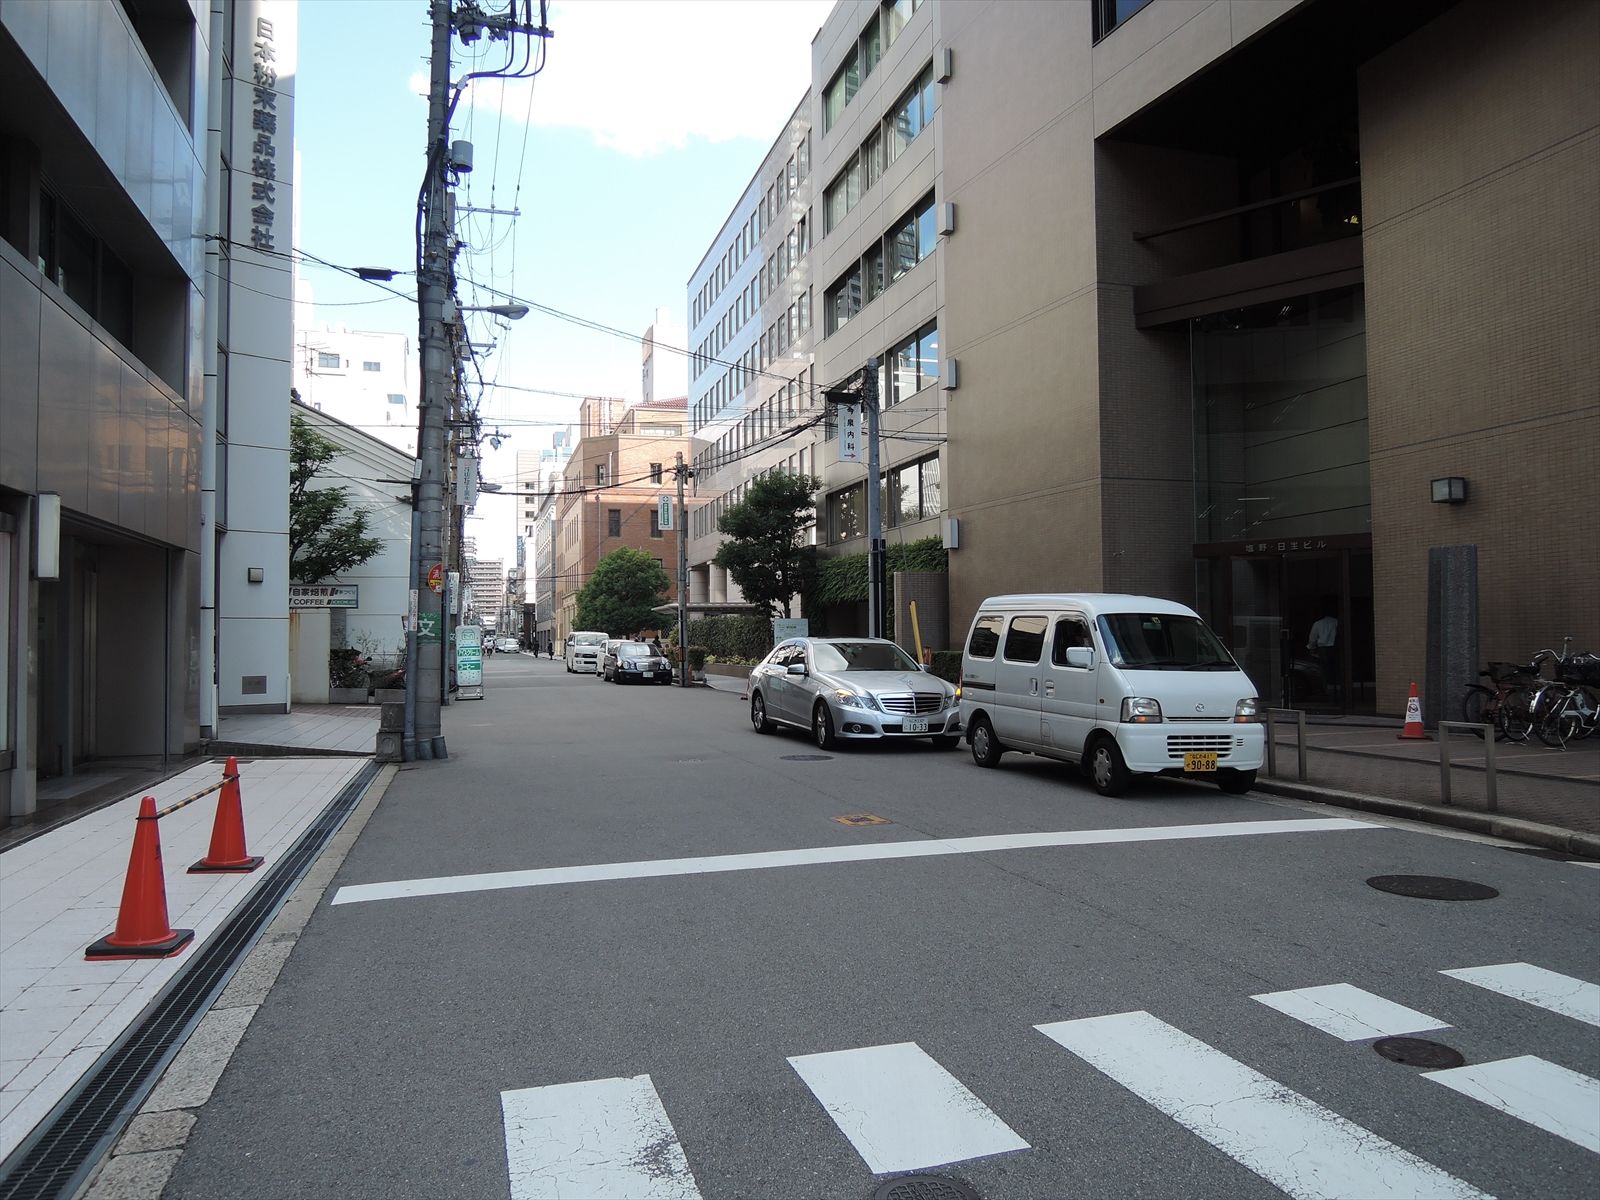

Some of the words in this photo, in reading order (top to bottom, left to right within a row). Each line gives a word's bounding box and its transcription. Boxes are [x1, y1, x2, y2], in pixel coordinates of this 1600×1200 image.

[252, 17, 278, 250] 日本粉末薬品株式会社
[292, 587, 329, 597] 自家焙煎
[293, 598, 325, 606] COFFEE
[417, 618, 436, 637] 文
[458, 663, 476, 671] コーヒー
[909, 723, 927, 731] 10-33
[1191, 760, 1216, 769] 90-88
